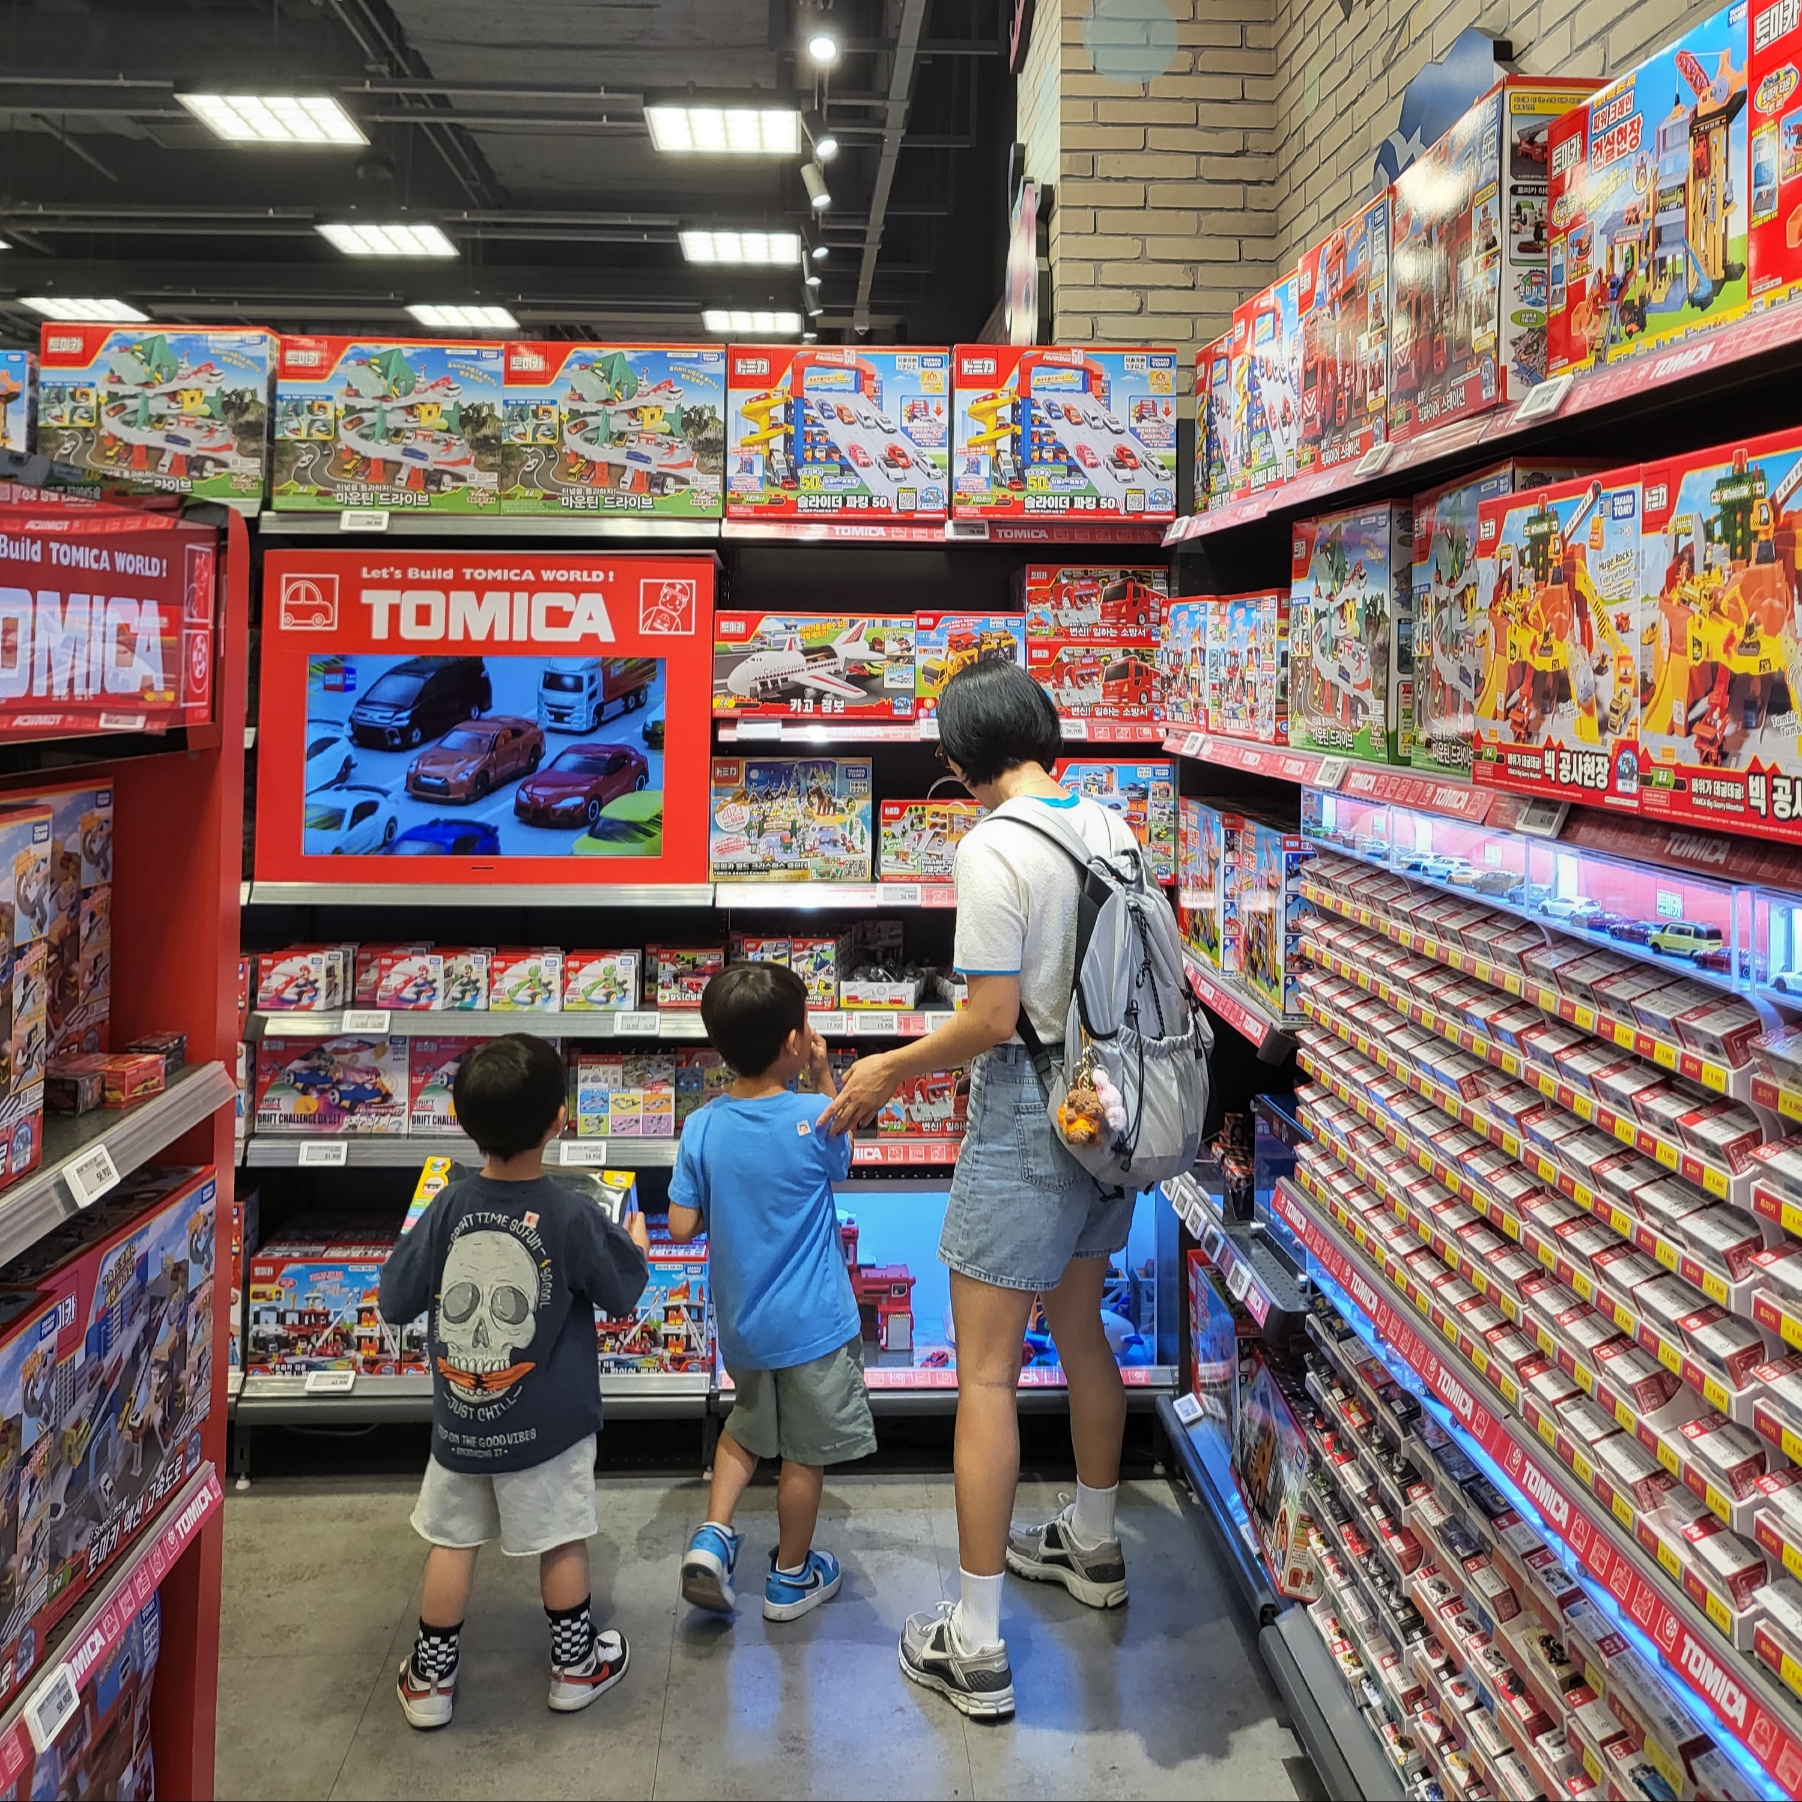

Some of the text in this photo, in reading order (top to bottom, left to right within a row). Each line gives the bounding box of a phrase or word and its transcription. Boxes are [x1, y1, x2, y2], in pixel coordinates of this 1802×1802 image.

[1754, 0, 1801, 54] 토미카
[1592, 89, 1634, 134] 파워 크레인
[1591, 111, 1643, 175] 건설현장
[1552, 132, 1582, 179] 토미카
[48, 336, 83, 353] 토미카
[286, 352, 321, 366] 토미카
[511, 356, 545, 371] 토미카
[844, 350, 855, 364] 50
[1071, 349, 1084, 364] 50
[1650, 343, 1715, 379] TOMICA
[735, 359, 769, 374] トミカ
[962, 358, 996, 374] トミカ
[336, 493, 431, 507] 마운틴 드라이브
[561, 496, 655, 510] 마운틴 드라이브
[797, 495, 888, 509] 슬라이더 파킹 50
[1024, 495, 1115, 510] 슬라이더 파킹 50
[1613, 493, 1634, 507] TAKARA
[1644, 483, 1668, 513] トミカ
[1613, 503, 1634, 517] TOMY
[833, 526, 886, 537] TOMICA
[996, 529, 1049, 539] TOMICA
[1479, 518, 1496, 540] トミカ
[49, 543, 111, 572] TOMICA
[1598, 549, 1633, 571] Huge Rocks
[361, 567, 402, 579] Let's
[408, 568, 454, 580] Build
[463, 569, 535, 582] TOMICA
[361, 589, 616, 643] TOMICA
[720, 621, 746, 634] 토미카
[1069, 627, 1146, 637] 변신! 일하는 소방서
[763, 664, 787, 675] CARGO
[790, 699, 845, 713] 카고 점보
[1071, 706, 1148, 717] 변신! 일하는 소방서
[1771, 711, 1799, 728] Tumble
[1312, 727, 1354, 748] 마운틴 드라이브
[1242, 751, 1260, 767] TOMICA
[1283, 758, 1305, 776] TOMICA
[716, 768, 737, 777] トミカ
[1507, 752, 1521, 767] 바위가
[1544, 749, 1556, 782] 빅
[1559, 750, 1610, 789] 공사현장
[1348, 771, 1376, 793] TOMICA
[1432, 786, 1470, 811] TOMICA
[1691, 777, 1712, 796] 바위가
[1713, 780, 1744, 801] 데굴데굴!
[1748, 774, 1767, 816] 빅
[721, 806, 743, 819] 2023
[1665, 831, 1731, 865] TOMICA
[1199, 979, 1216, 1001] TOMICA
[1243, 1014, 1263, 1040] TOMICA
[257, 1113, 277, 1124] DRIFT
[278, 1113, 317, 1124] CHALLENGE
[329, 1113, 341, 1124] SET
[411, 1114, 430, 1125] DRIFT
[921, 1122, 942, 1132] 변신!
[476, 1212, 510, 1227] TIME
[1285, 1199, 1307, 1234] TOMICA
[1351, 1271, 1378, 1315] TOMICA
[1436, 1366, 1474, 1421] TOMICA
[447, 1396, 517, 1421] JUST CHILL
[461, 1434, 477, 1447] THE
[478, 1434, 506, 1448] GOOD
[506, 1428, 537, 1445] VIBES
[1521, 1459, 1569, 1530] TOMICA
[174, 1484, 213, 1540] TOMICA
[86, 1519, 121, 1580] 토미카
[1680, 1633, 1748, 1728] TOMICA
